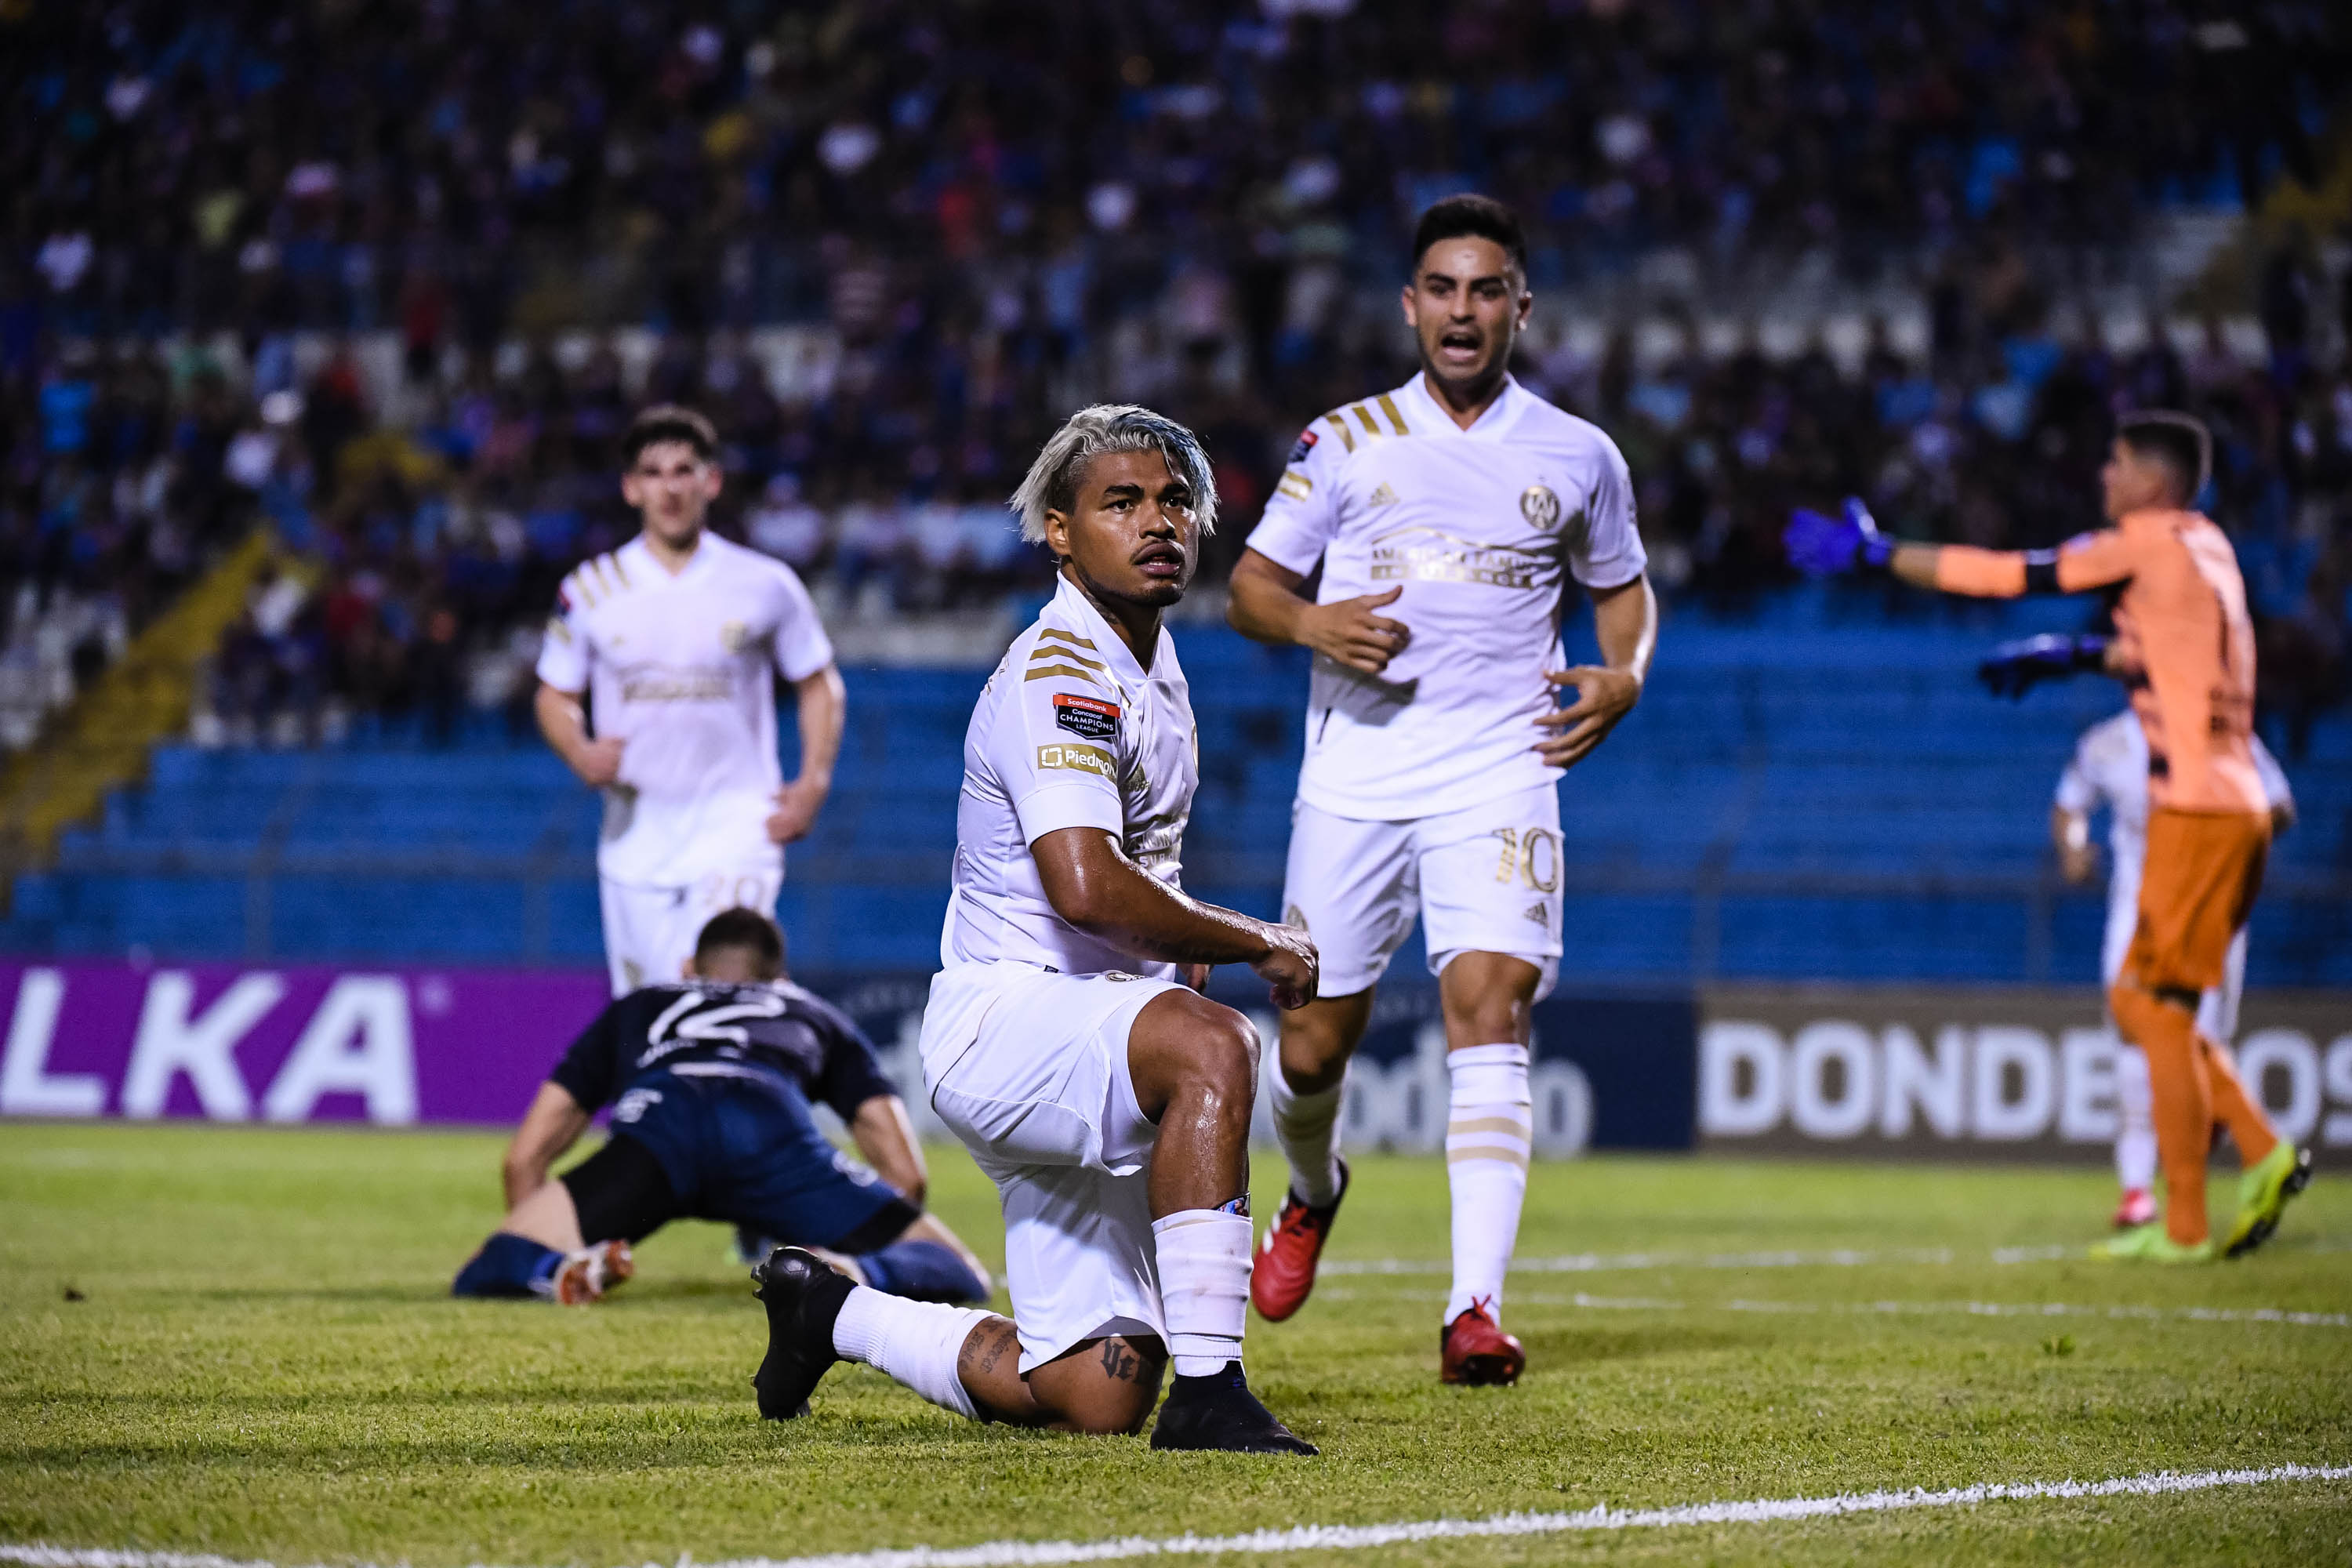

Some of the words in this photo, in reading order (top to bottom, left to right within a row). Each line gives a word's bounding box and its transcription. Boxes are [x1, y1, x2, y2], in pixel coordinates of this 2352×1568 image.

[1059, 713, 1114, 731] CHAMPIONS
[1067, 698, 1107, 712] Scotiabank
[1072, 708, 1103, 720] Concacaf
[1492, 827, 1559, 893] 10
[0, 967, 419, 1124] LKA
[1698, 1021, 2120, 1142] DONDE
